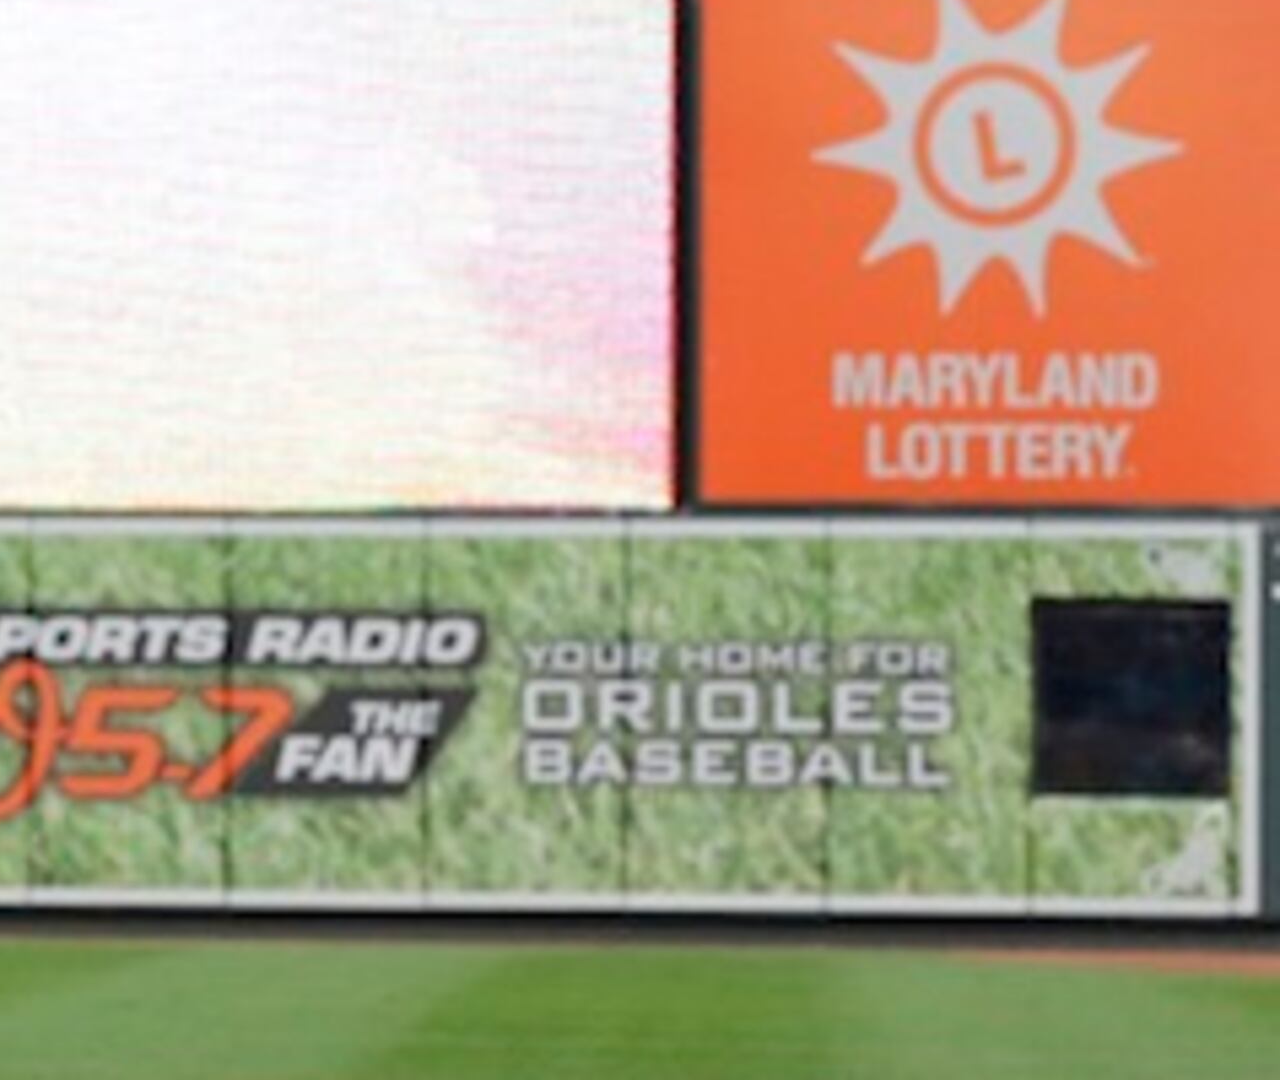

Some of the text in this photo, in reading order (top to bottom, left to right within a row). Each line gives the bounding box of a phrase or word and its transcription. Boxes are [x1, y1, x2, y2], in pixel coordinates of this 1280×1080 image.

[833, 353, 1158, 409] MARYLAND
[867, 425, 1131, 478] LOTTERY
[246, 616, 480, 664] RADIO
[522, 640, 950, 675] YOUR HOME FOR
[350, 698, 442, 736] THE
[522, 678, 955, 734] ORIOLES
[274, 736, 422, 782] FAN
[522, 740, 952, 786] BASEBALL
